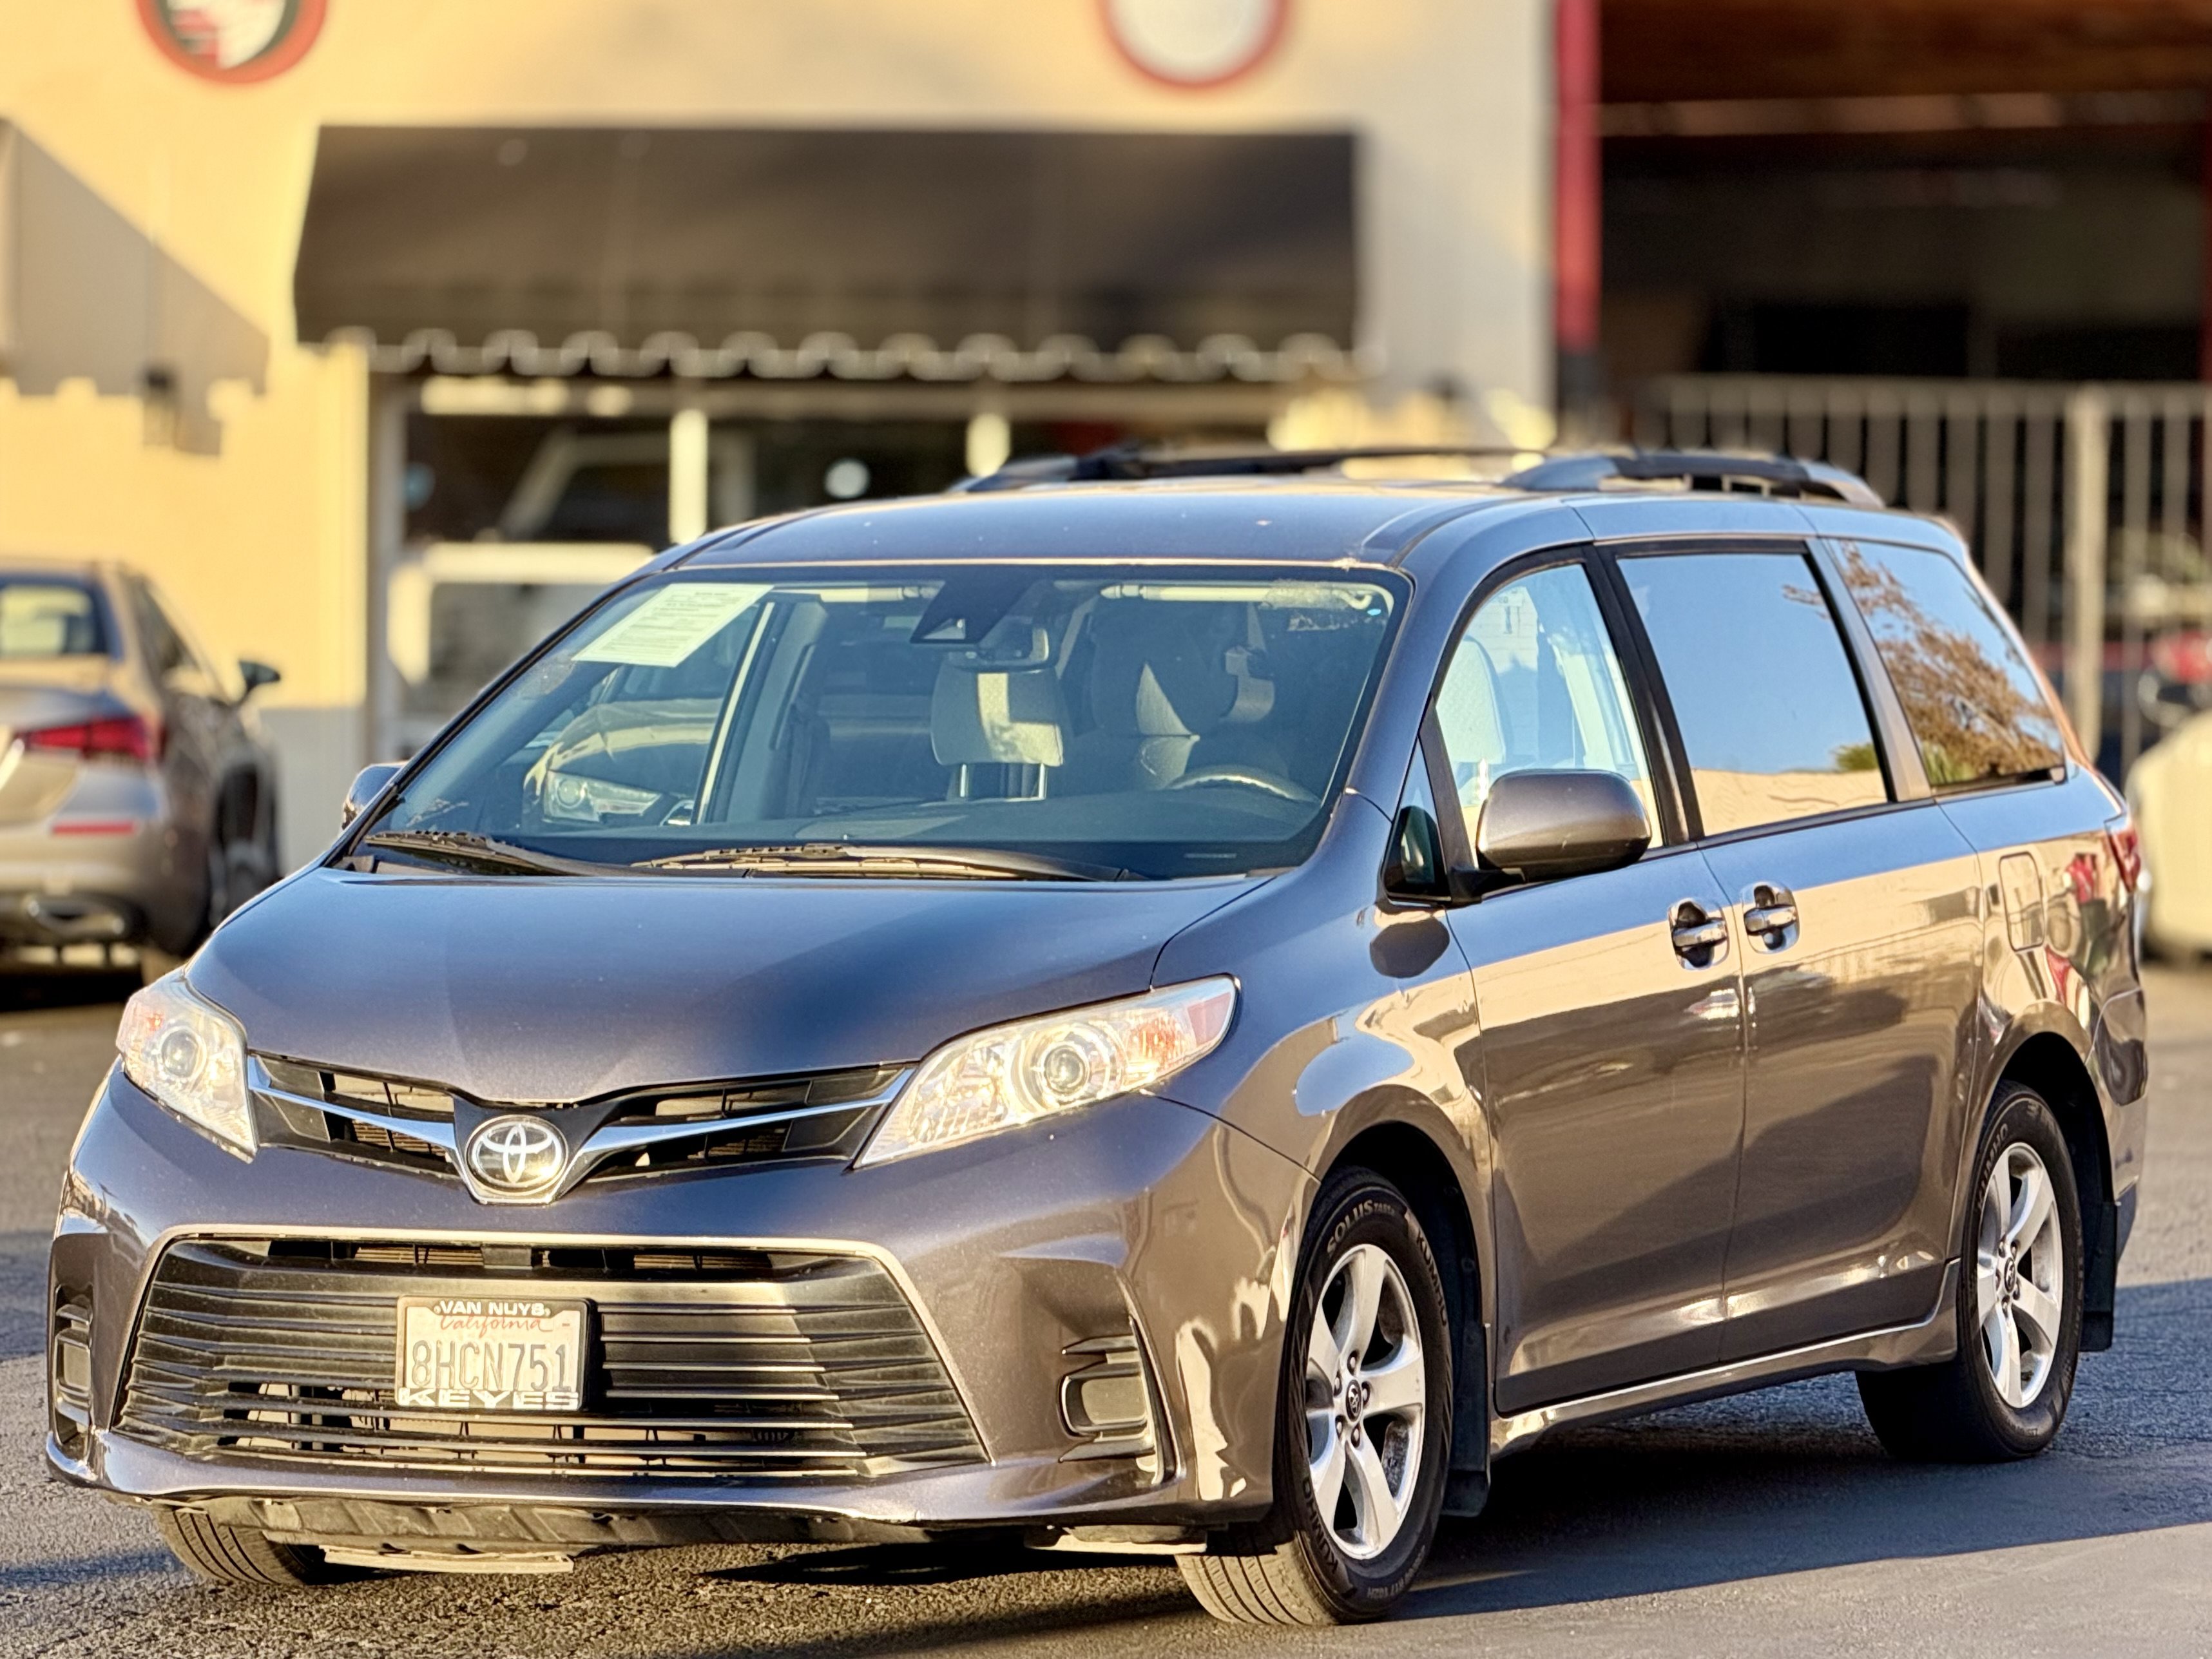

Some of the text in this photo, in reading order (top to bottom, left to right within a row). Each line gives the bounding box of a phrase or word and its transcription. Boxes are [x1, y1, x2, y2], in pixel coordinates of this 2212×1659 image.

[1327, 1200, 1373, 1258] SOLUS
[440, 1300, 481, 1315] VAN
[440, 1314, 553, 1339] California
[412, 1339, 573, 1393] 8HCN751
[398, 1387, 579, 1410] KEYES
